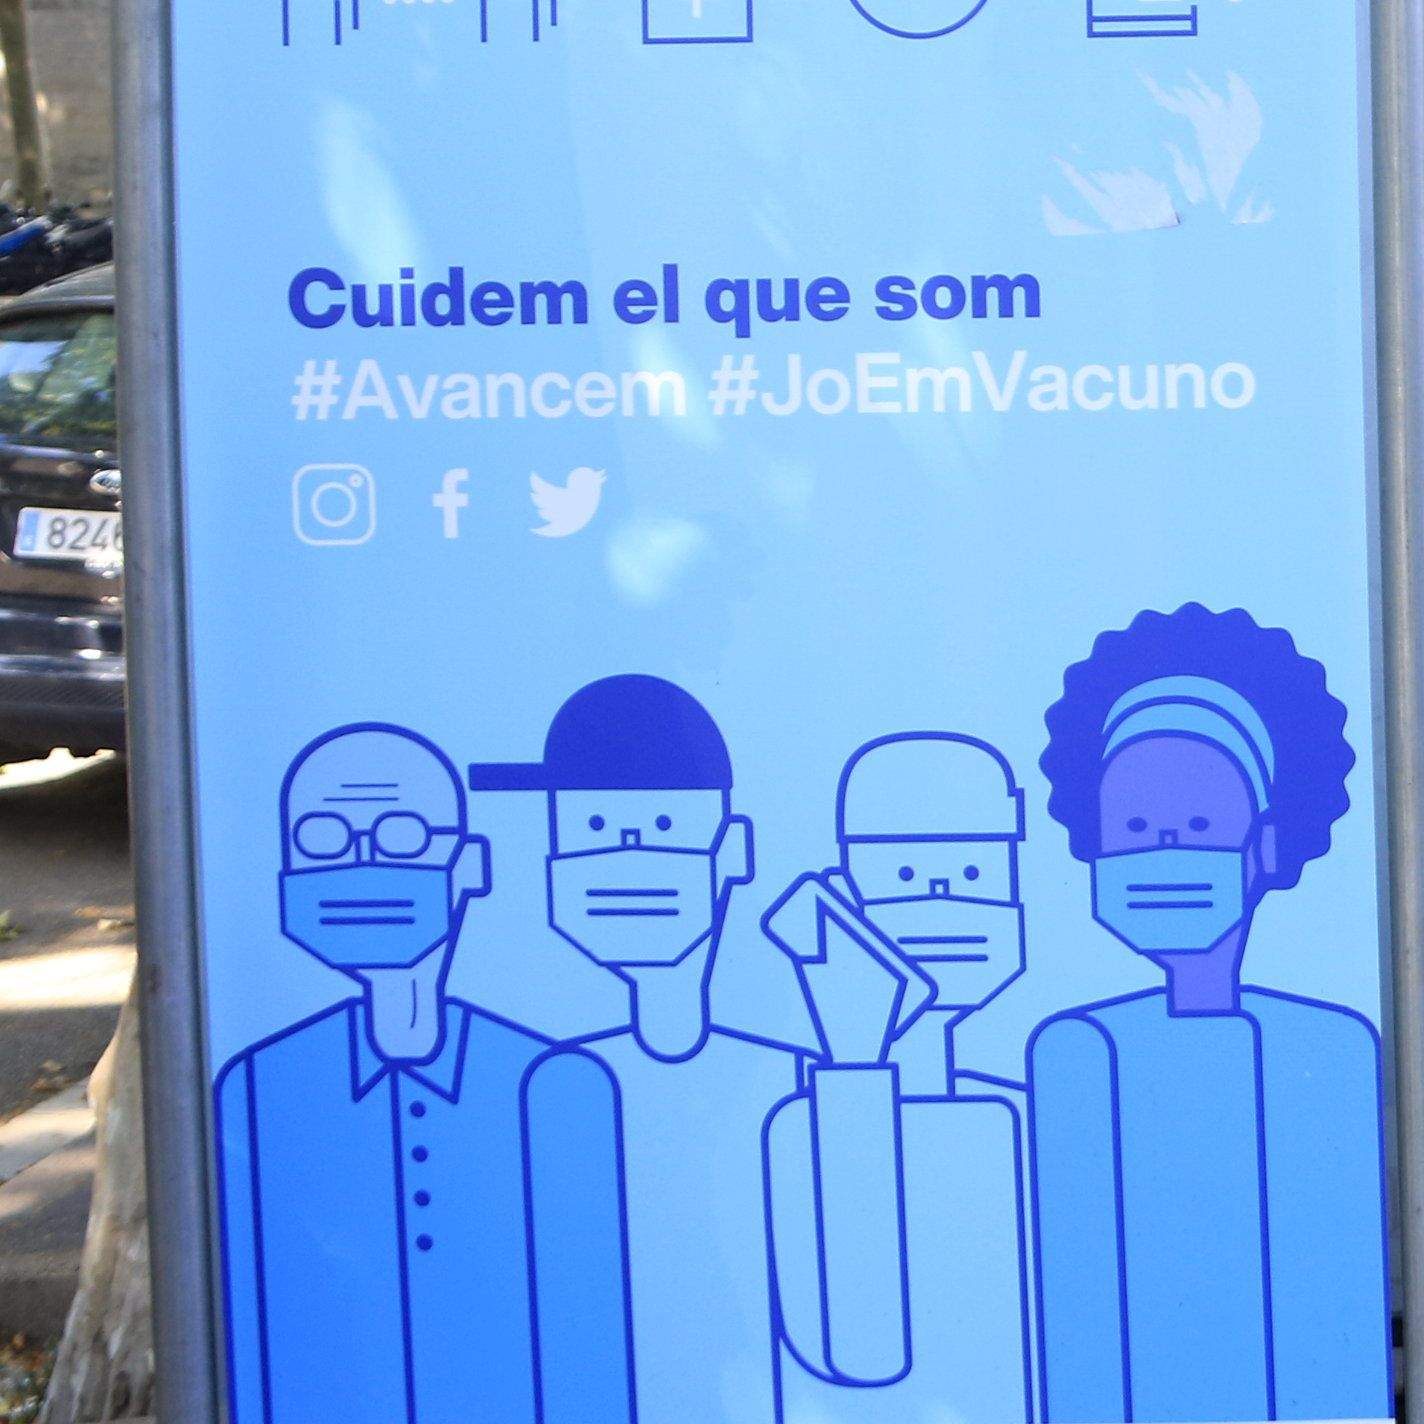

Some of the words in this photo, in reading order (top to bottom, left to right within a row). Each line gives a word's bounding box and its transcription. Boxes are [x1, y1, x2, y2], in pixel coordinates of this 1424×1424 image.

[287, 266, 589, 329] Cuidem
[613, 263, 680, 324] el
[706, 276, 851, 339] que
[875, 273, 1041, 321] som
[291, 358, 688, 421] #Avancem
[708, 350, 1256, 416] #JoEmVacuno
